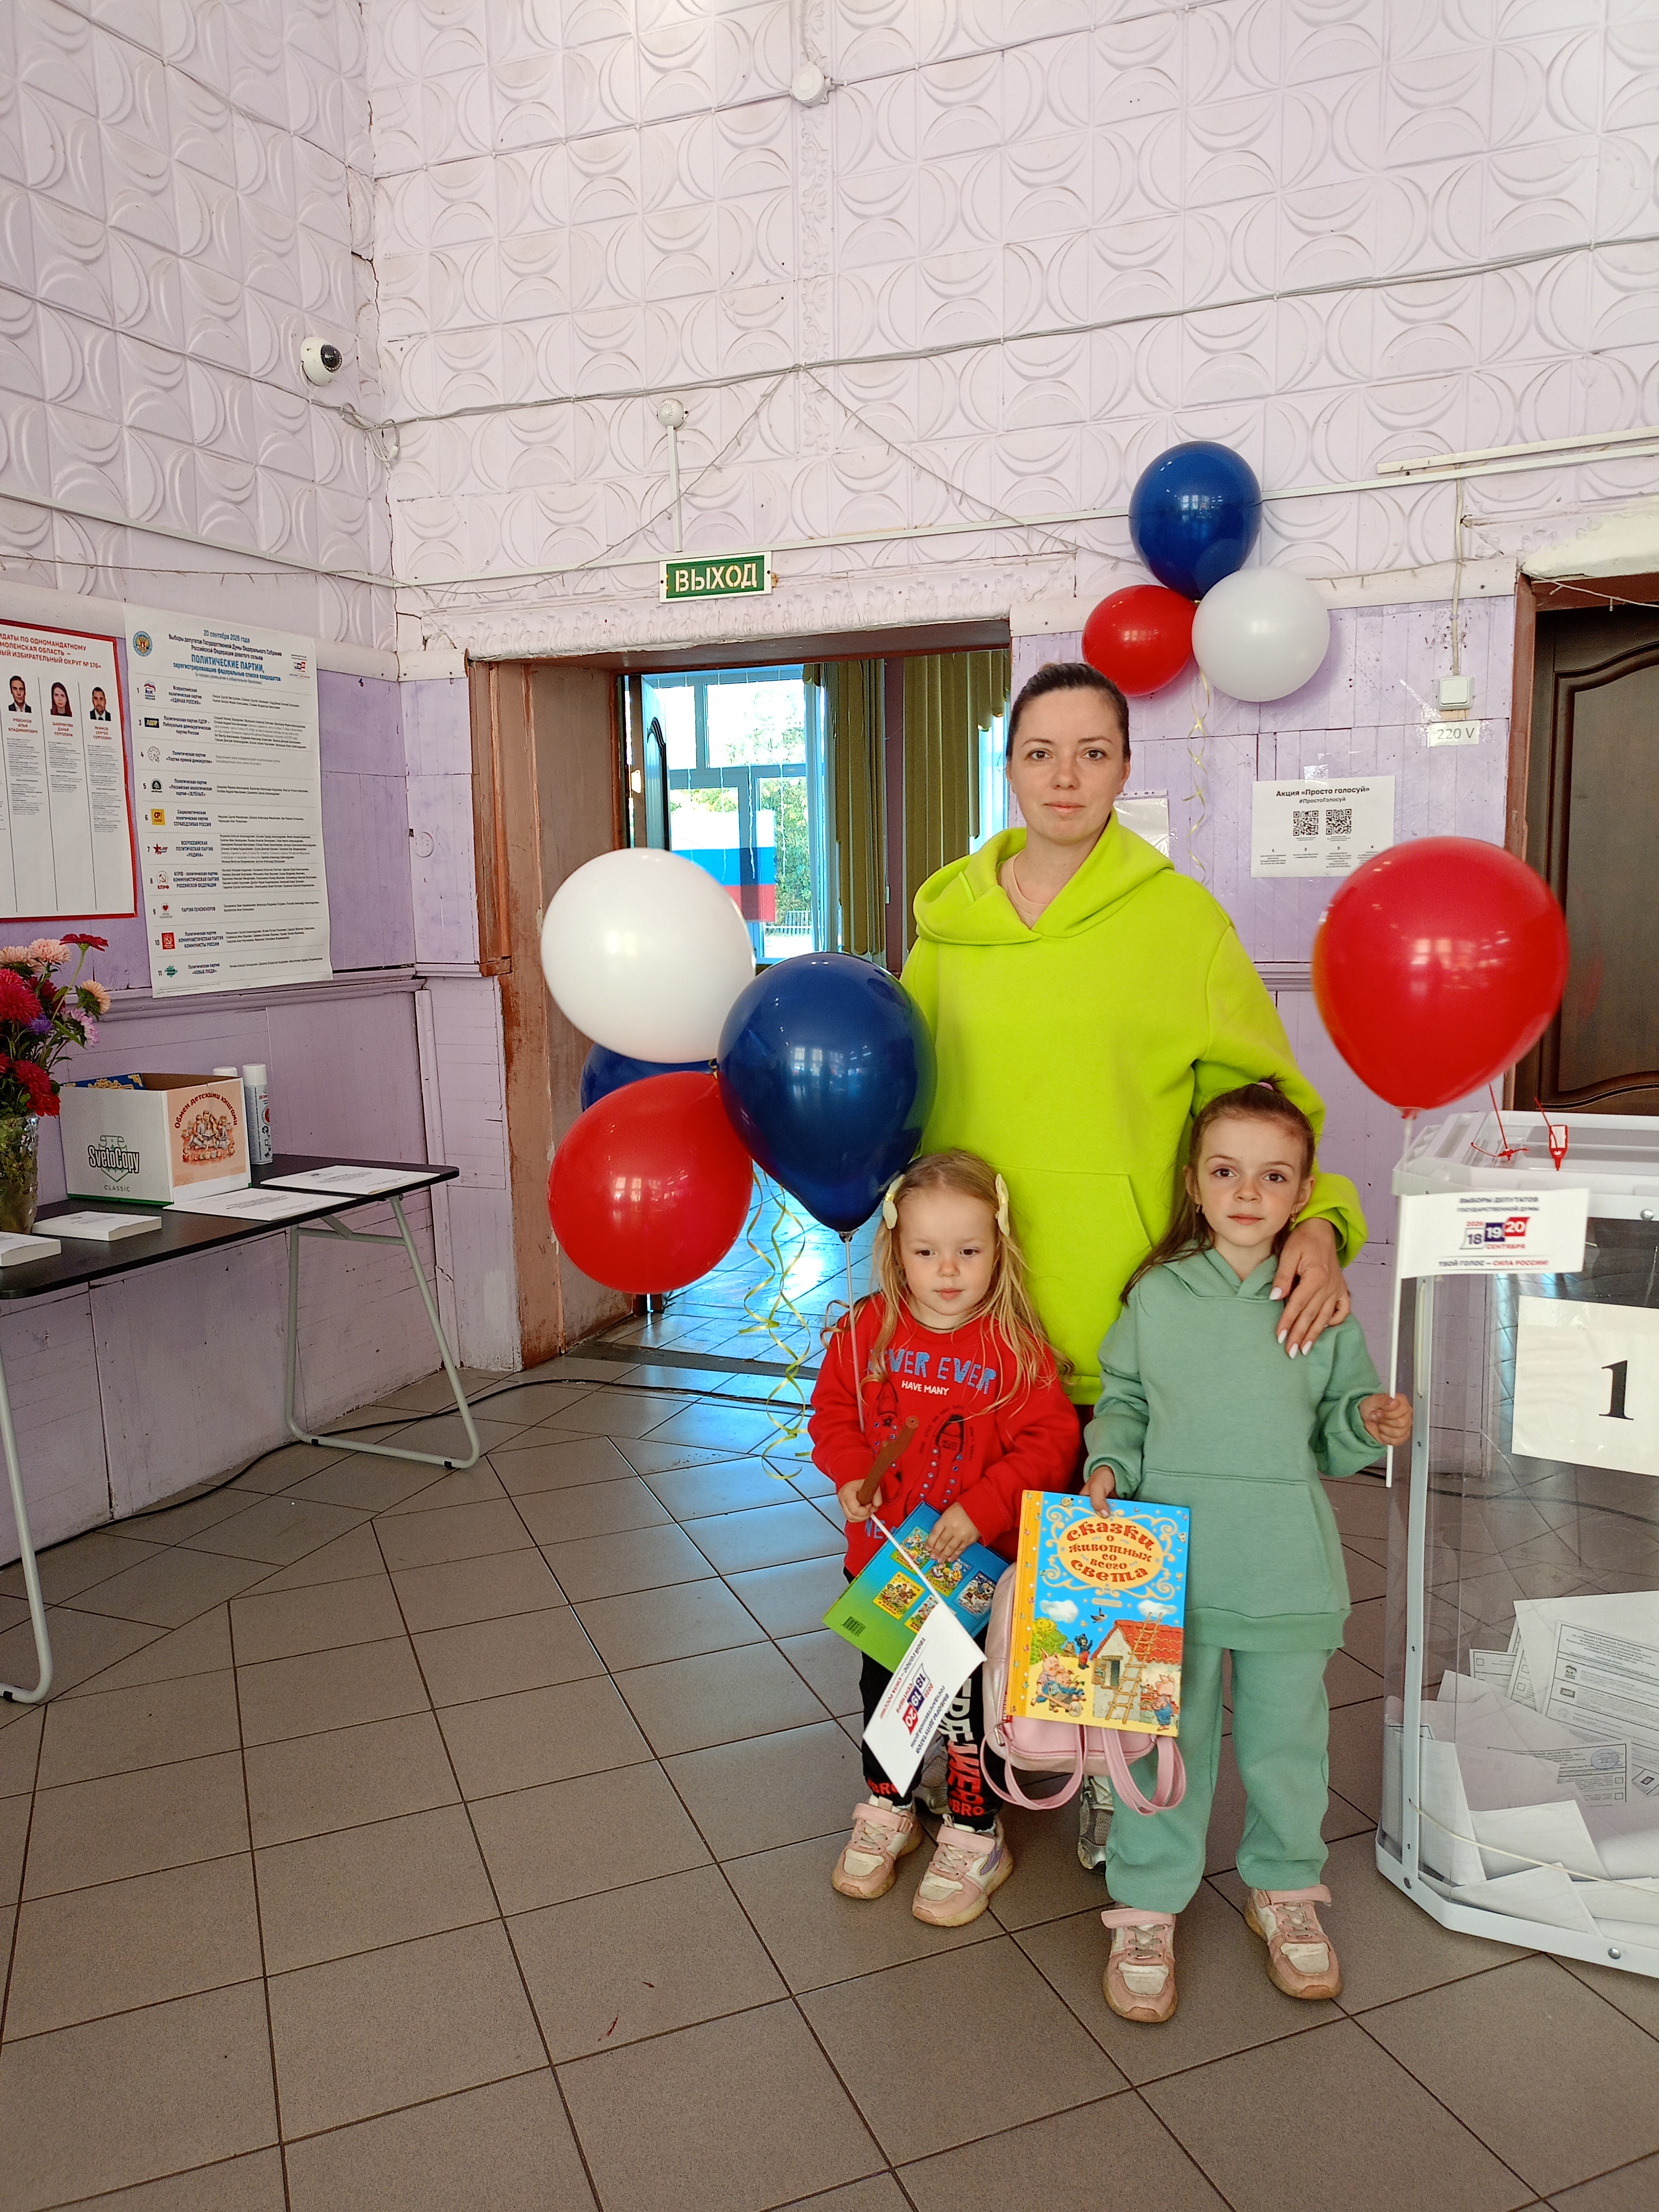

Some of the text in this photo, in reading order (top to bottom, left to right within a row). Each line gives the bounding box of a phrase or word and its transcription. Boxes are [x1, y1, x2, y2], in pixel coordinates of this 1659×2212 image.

[675, 563, 757, 592] ВЫХОД
[30, 638, 86, 651] ОДНОМАНДАТНОМУ
[210, 632, 229, 640] сентября
[39, 647, 64, 655] ОБЛАСТЬ
[191, 644, 212, 653] Российской
[203, 639, 232, 648] Государственной
[243, 645, 266, 654] Федерального
[12, 652, 63, 664] ИЗБИРАТЕЛЬНЫЙ
[191, 654, 264, 673] ПОЛИТИЧЕСКИЕ ПАРТИИ,
[173, 663, 216, 673] зарегистрировавшие
[218, 668, 244, 676] федеральные
[1437, 728, 1474, 739] 220 V
[1335, 785, 1370, 794] голосуй»
[175, 1093, 238, 1128] Обмен детскими книгами
[88, 1145, 140, 1173] SvetoCopy
[1468, 1221, 1526, 1244] 18 19 20
[938, 1357, 996, 1394] EVER
[902, 1380, 950, 1396] HAVE MANY
[1599, 1360, 1634, 1420] 1
[1069, 1543, 1152, 1562] животных
[1090, 1559, 1127, 1570] всего
[916, 1637, 926, 1654] ТВОЙ
[903, 1653, 917, 1673] ГОЛОС
[892, 1677, 902, 1694] СИЛА
[896, 1683, 912, 1713] СЕНТЯБРЯ
[905, 1673, 926, 1727] 18 19 20
[910, 1685, 945, 1748] ГОСУДАРСТВЕННОЙ ДУМЫ
[916, 1693, 950, 1754] ВЫБОРЫ ДЕПУТАТОВ
